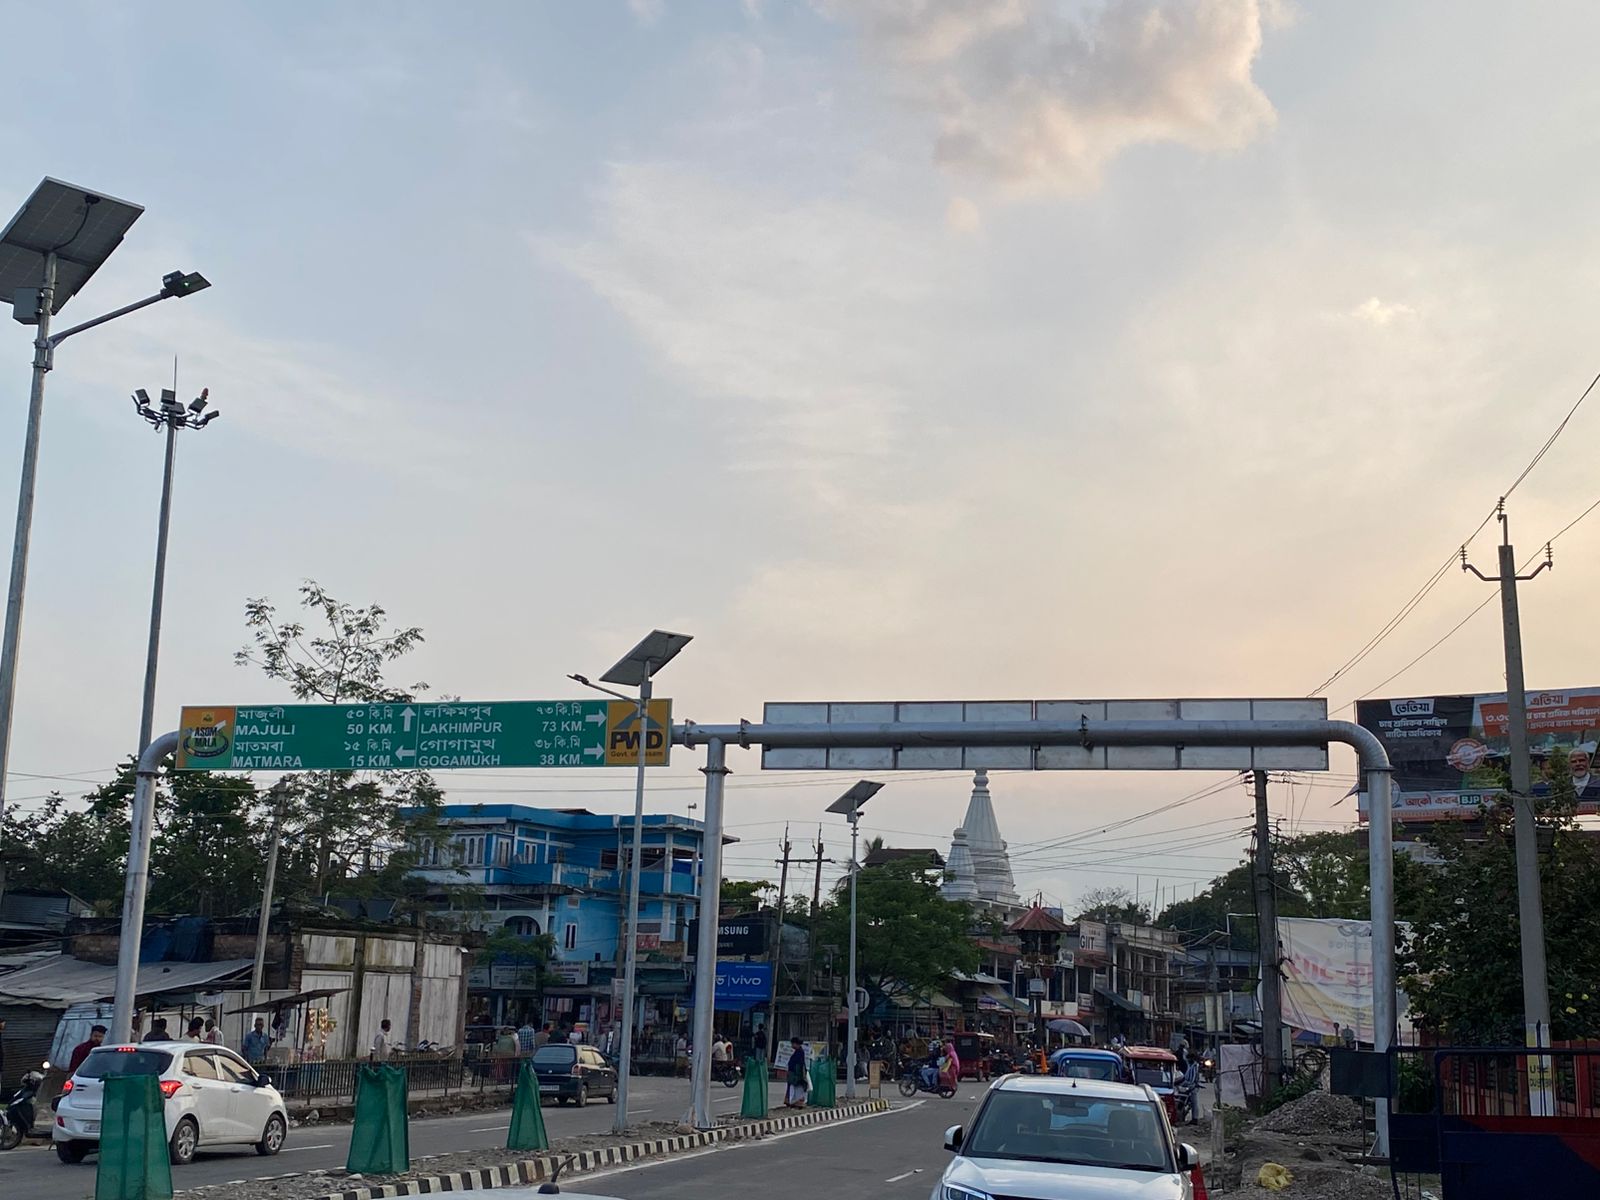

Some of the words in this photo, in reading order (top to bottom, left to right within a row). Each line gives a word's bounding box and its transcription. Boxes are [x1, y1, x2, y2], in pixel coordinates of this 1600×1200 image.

[536, 706, 554, 715] ৭৩
[1395, 700, 1430, 714] তেতিয়া
[238, 706, 285, 723] মাজুলী
[346, 709, 364, 719] ৫০
[194, 726, 218, 737] ASOM
[235, 724, 296, 736] MAJULI
[346, 723, 364, 735] 50
[368, 723, 396, 735] KM.
[420, 722, 503, 734] LAKHIMPUR
[541, 720, 557, 732] 73
[561, 720, 586, 732] KM.
[343, 740, 361, 751] ১৫
[419, 738, 496, 754] গোগামুখ
[534, 739, 553, 749] ৩৮
[610, 731, 663, 749] PWD
[232, 755, 303, 768] MATMARA
[348, 755, 365, 767] 15
[368, 755, 394, 767] KM.
[418, 755, 501, 767] GOGAMUKH
[539, 754, 555, 765] 38
[559, 753, 584, 765] KM.
[1461, 796, 1480, 804] BJP
[731, 975, 762, 985] vivo
